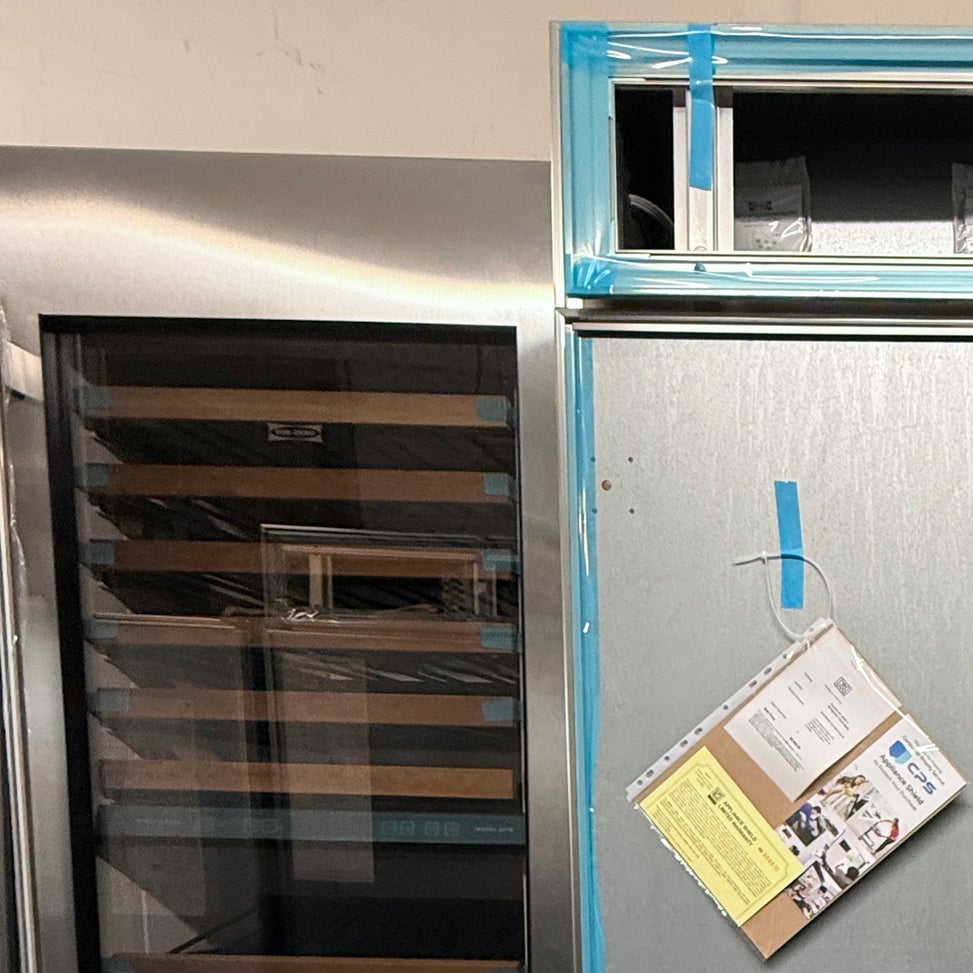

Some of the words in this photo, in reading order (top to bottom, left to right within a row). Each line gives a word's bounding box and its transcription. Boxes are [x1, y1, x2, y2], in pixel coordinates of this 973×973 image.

[900, 733, 922, 758] Consuer
[878, 752, 908, 787] Appliance
[904, 783, 925, 806] Shield
[904, 759, 937, 796] CPS
[716, 802, 734, 823] LIMITED
[730, 819, 754, 847] WARRANTY
[721, 799, 745, 826] APPLIANCE
[741, 823, 758, 842] SHIELD
